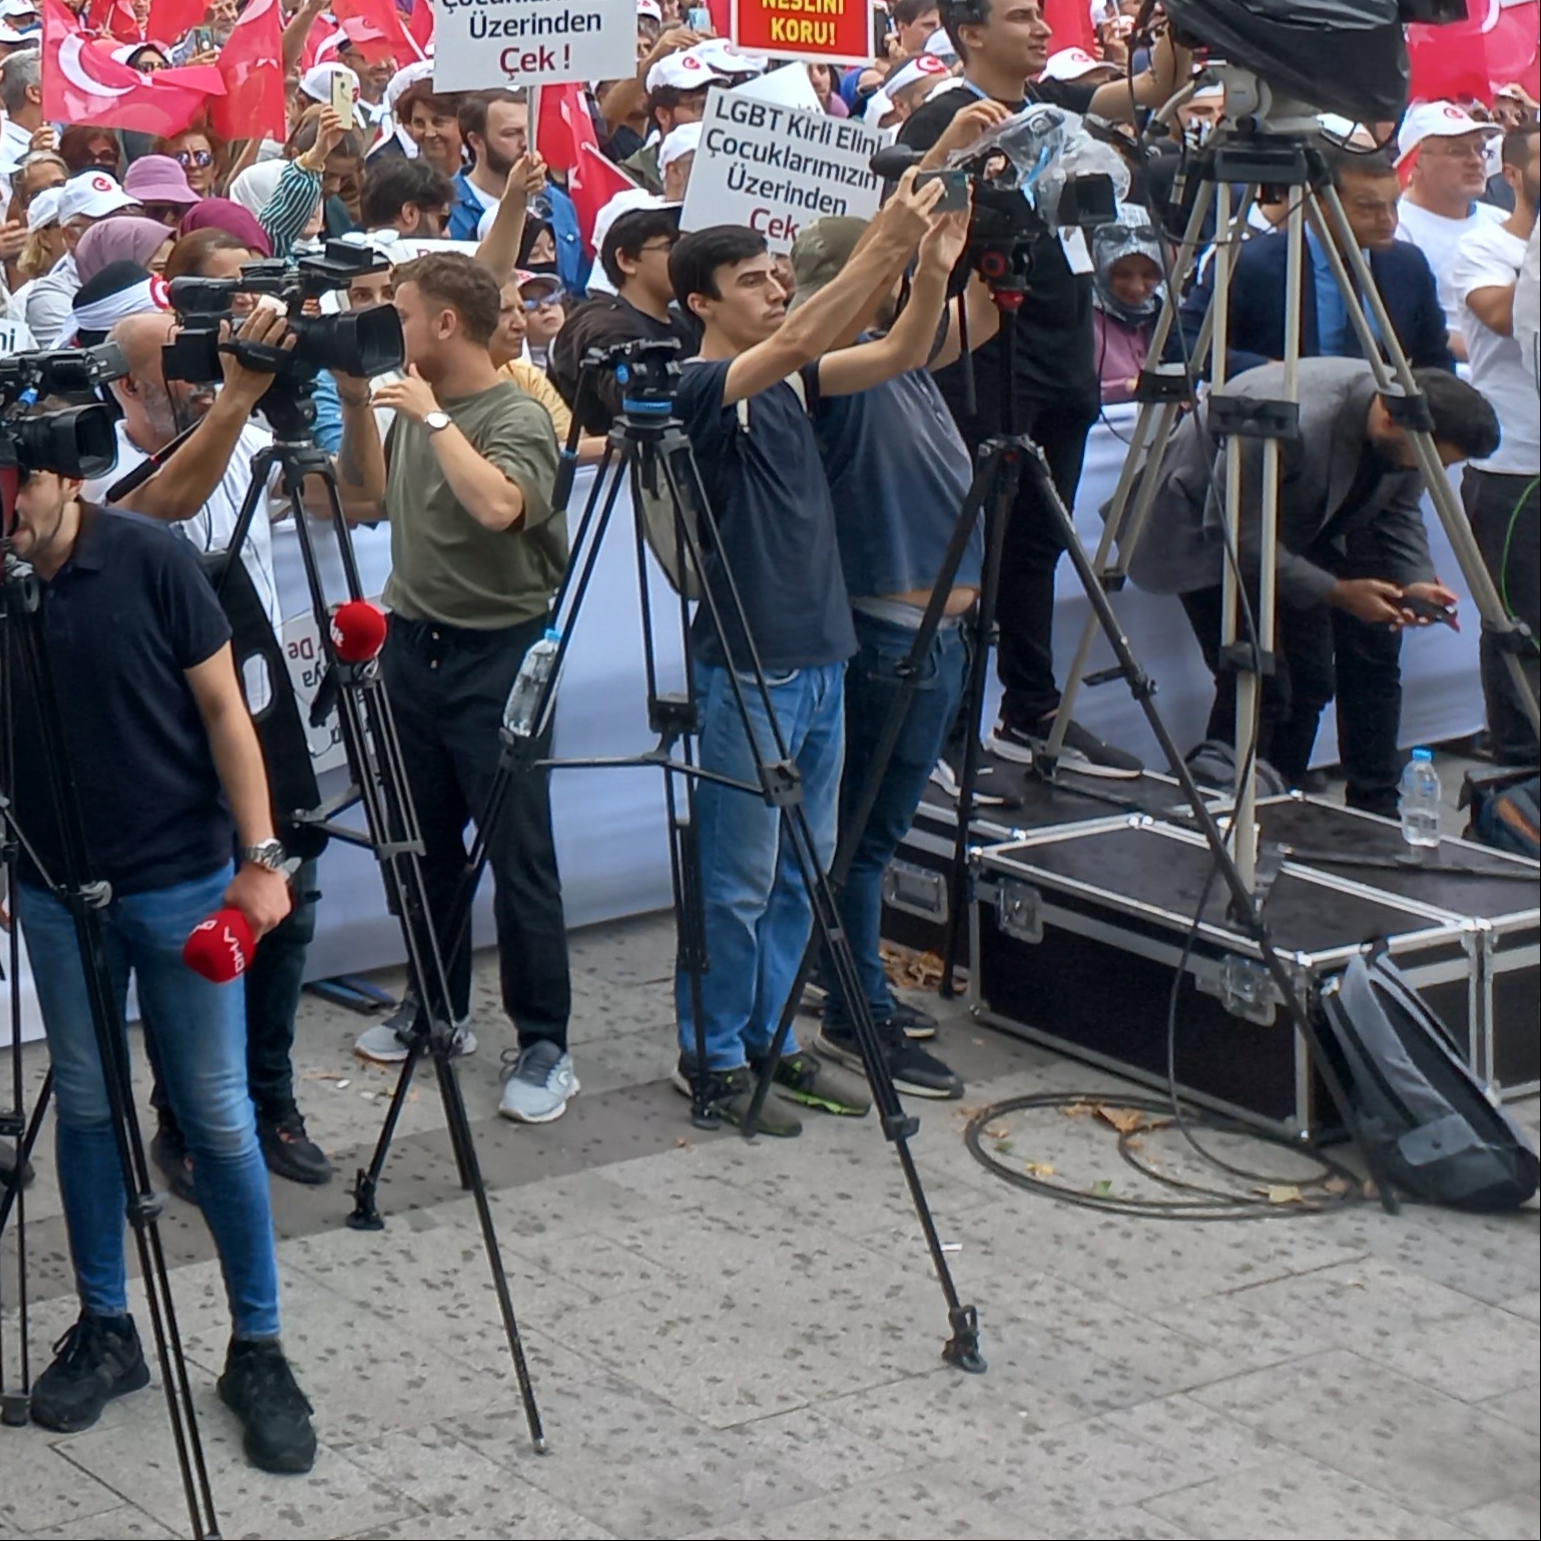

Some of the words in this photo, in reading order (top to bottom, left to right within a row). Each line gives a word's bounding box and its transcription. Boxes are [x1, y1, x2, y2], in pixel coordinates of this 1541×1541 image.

[469, 9, 601, 39] Üzerinden
[771, 17, 836, 46] KORU!
[500, 45, 556, 81] Çek
[716, 96, 783, 131] LGBT
[787, 114, 833, 145] Kirli
[835, 126, 883, 156] Elini
[706, 129, 878, 191] Çocuklarımızın
[727, 162, 847, 216] Üzerinden
